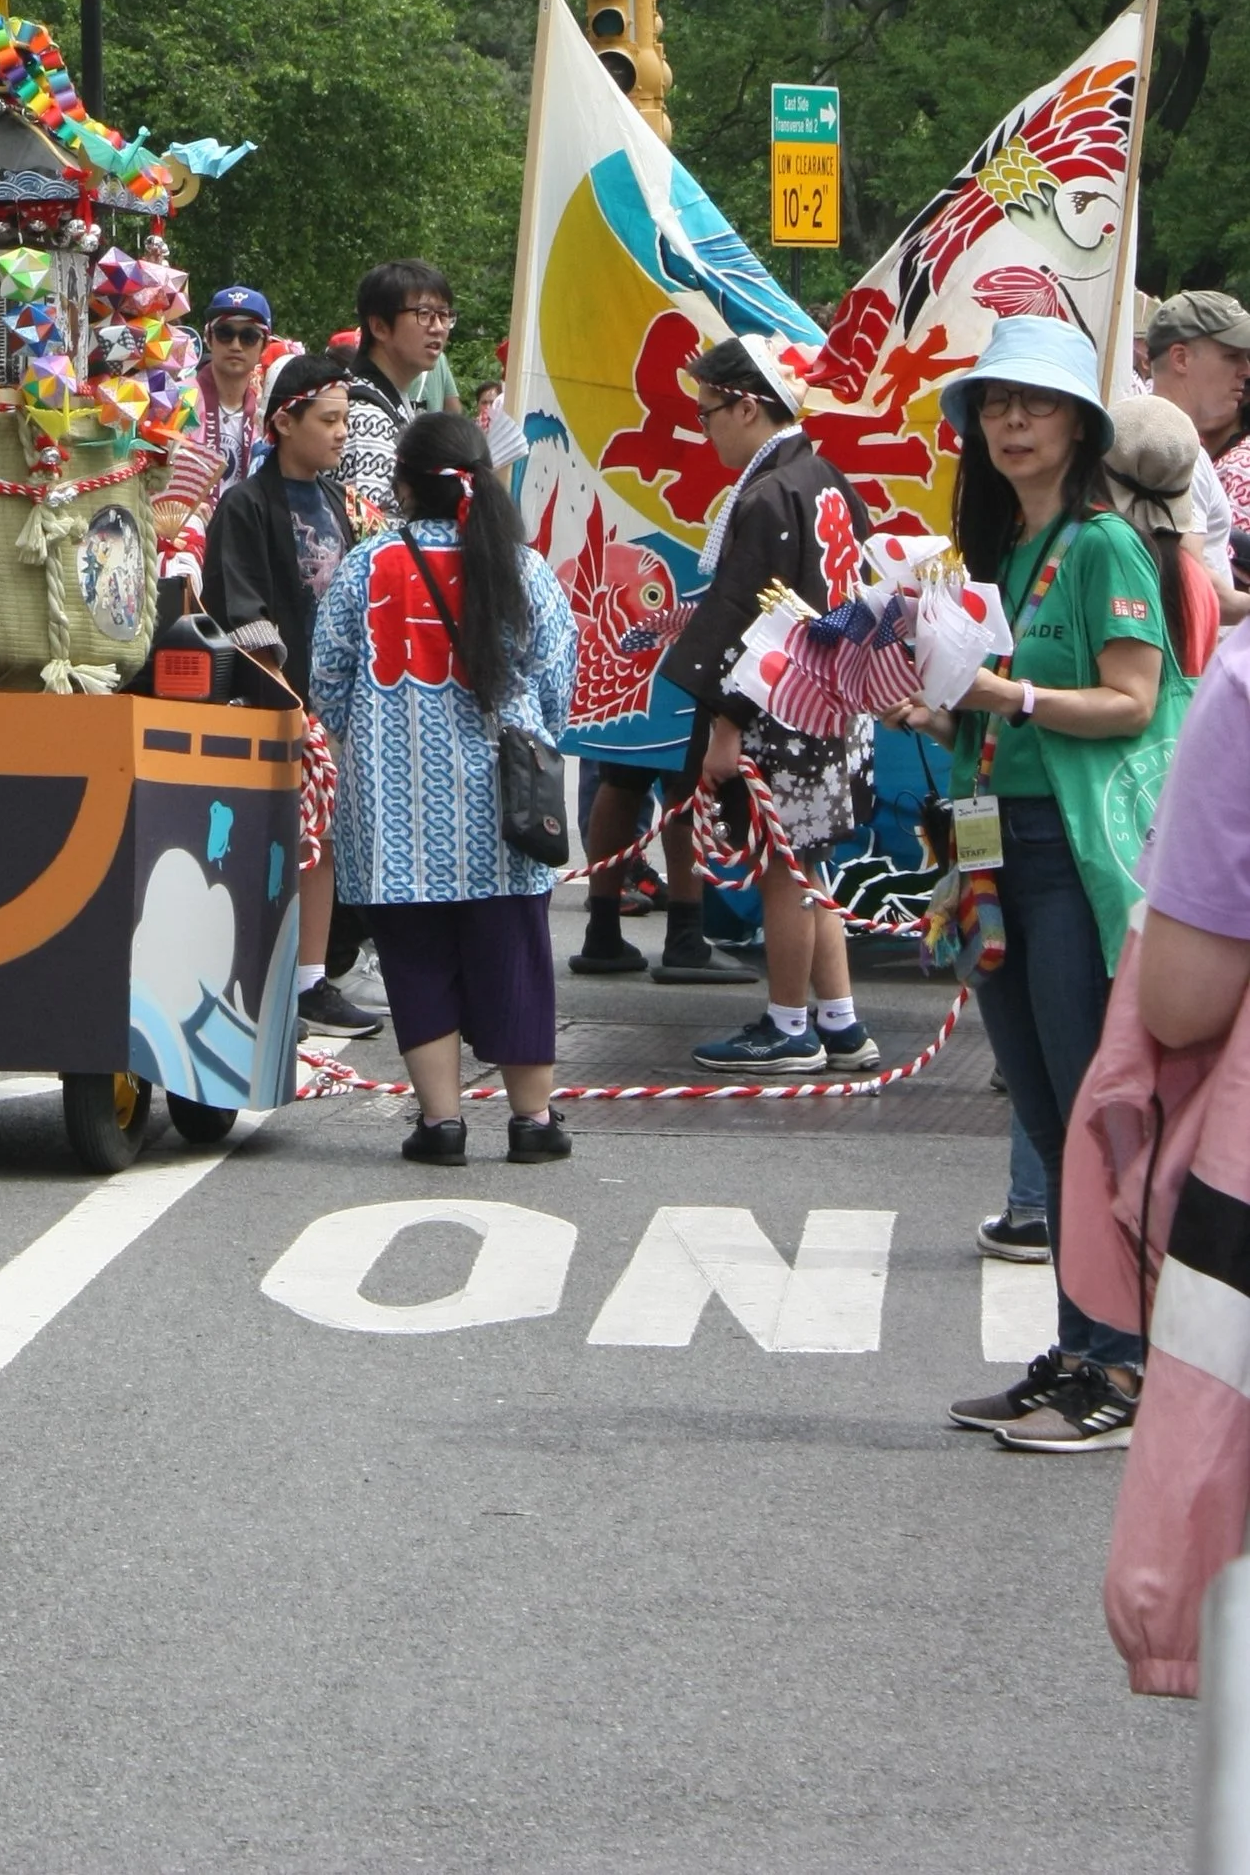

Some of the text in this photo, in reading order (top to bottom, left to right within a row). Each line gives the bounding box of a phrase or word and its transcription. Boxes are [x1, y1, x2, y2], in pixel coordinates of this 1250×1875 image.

[784, 95, 810, 112] East Side
[774, 117, 805, 133] Transverse
[813, 119, 819, 134] 2
[777, 154, 835, 177] LOW CLEARANCE
[1024, 624, 1065, 640] ADE
